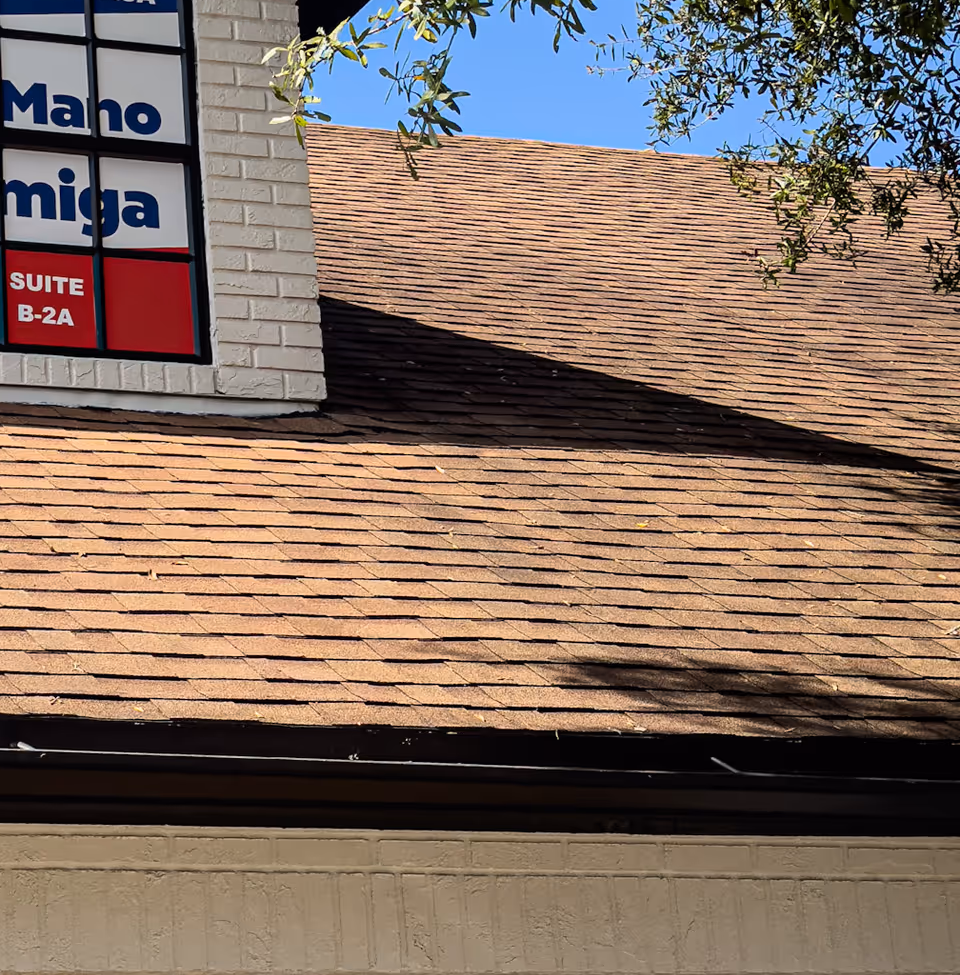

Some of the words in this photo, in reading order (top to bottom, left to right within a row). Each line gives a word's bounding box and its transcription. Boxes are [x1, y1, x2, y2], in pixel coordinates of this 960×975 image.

[1, 79, 162, 135] Mano
[10, 272, 84, 296] SUITE
[18, 304, 74, 327] B-2A
